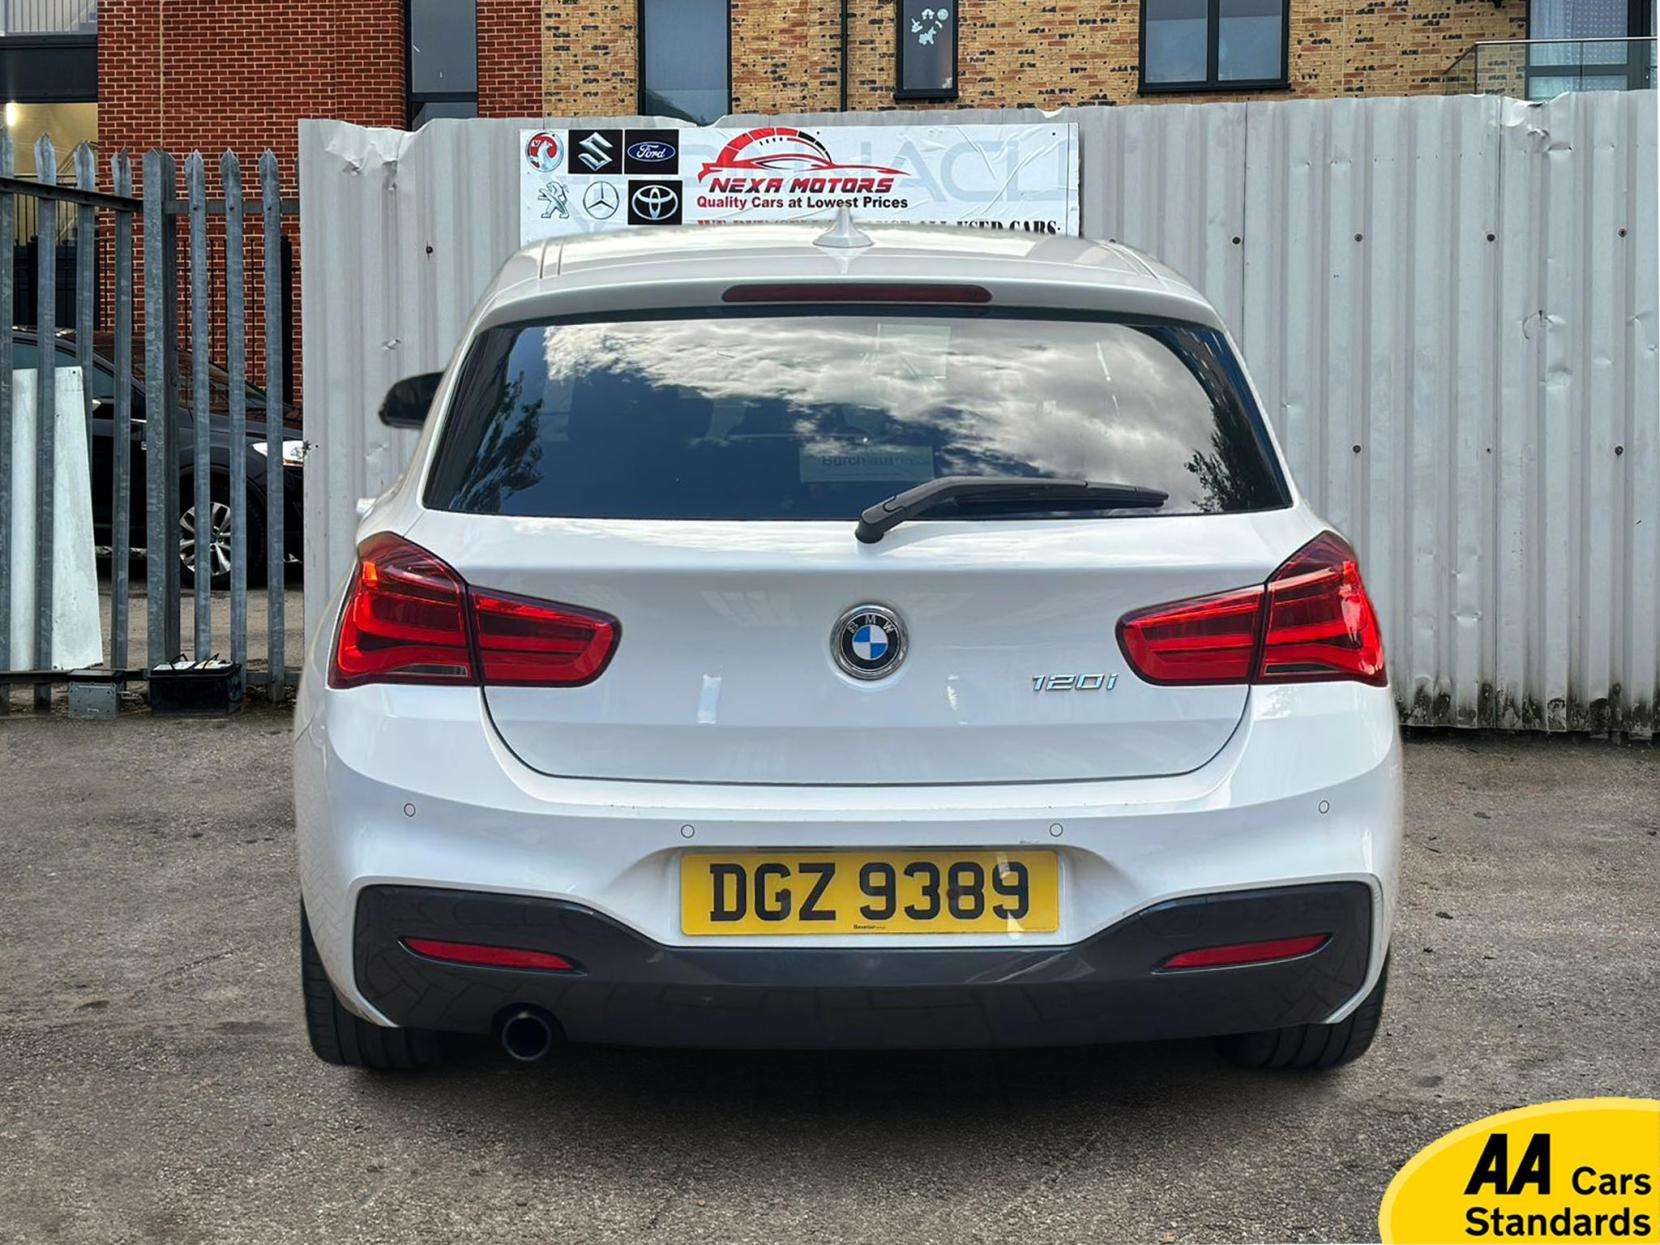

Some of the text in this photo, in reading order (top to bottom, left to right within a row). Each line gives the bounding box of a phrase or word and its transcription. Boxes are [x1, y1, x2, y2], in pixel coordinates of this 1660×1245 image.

[636, 144, 667, 159] Ford
[709, 178, 894, 193] NEXA MOTORS
[697, 196, 908, 211] Quality Cars at Lowest Prices
[846, 614, 896, 634] BMW
[1032, 672, 1119, 691] 120i
[709, 861, 1029, 922] DGZ 9389
